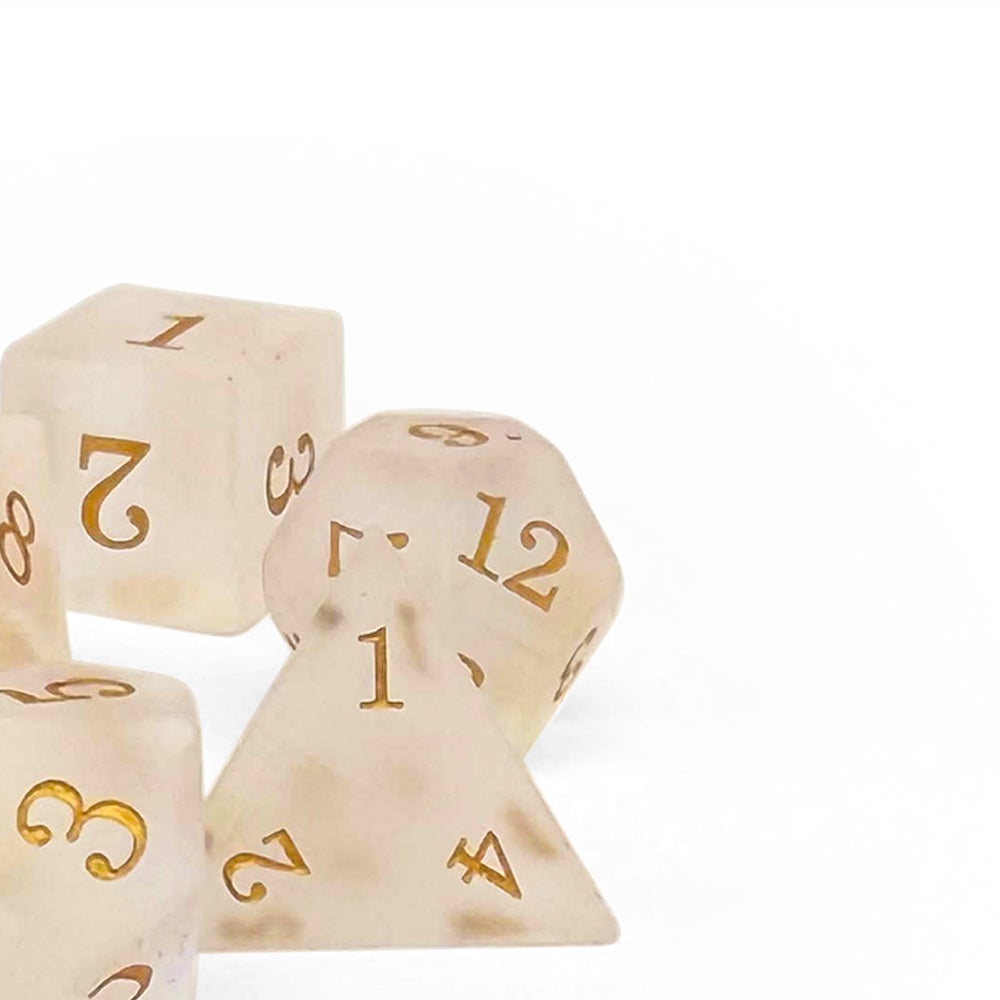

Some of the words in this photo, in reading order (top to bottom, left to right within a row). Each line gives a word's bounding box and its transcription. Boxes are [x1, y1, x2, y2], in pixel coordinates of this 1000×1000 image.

[125, 314, 205, 351] 1
[78, 433, 151, 550] 2
[265, 432, 316, 516] 3
[457, 491, 570, 613] 12
[357, 626, 405, 710] 1
[15, 778, 148, 882] 3
[222, 828, 312, 903] 2
[446, 830, 523, 900] 4
